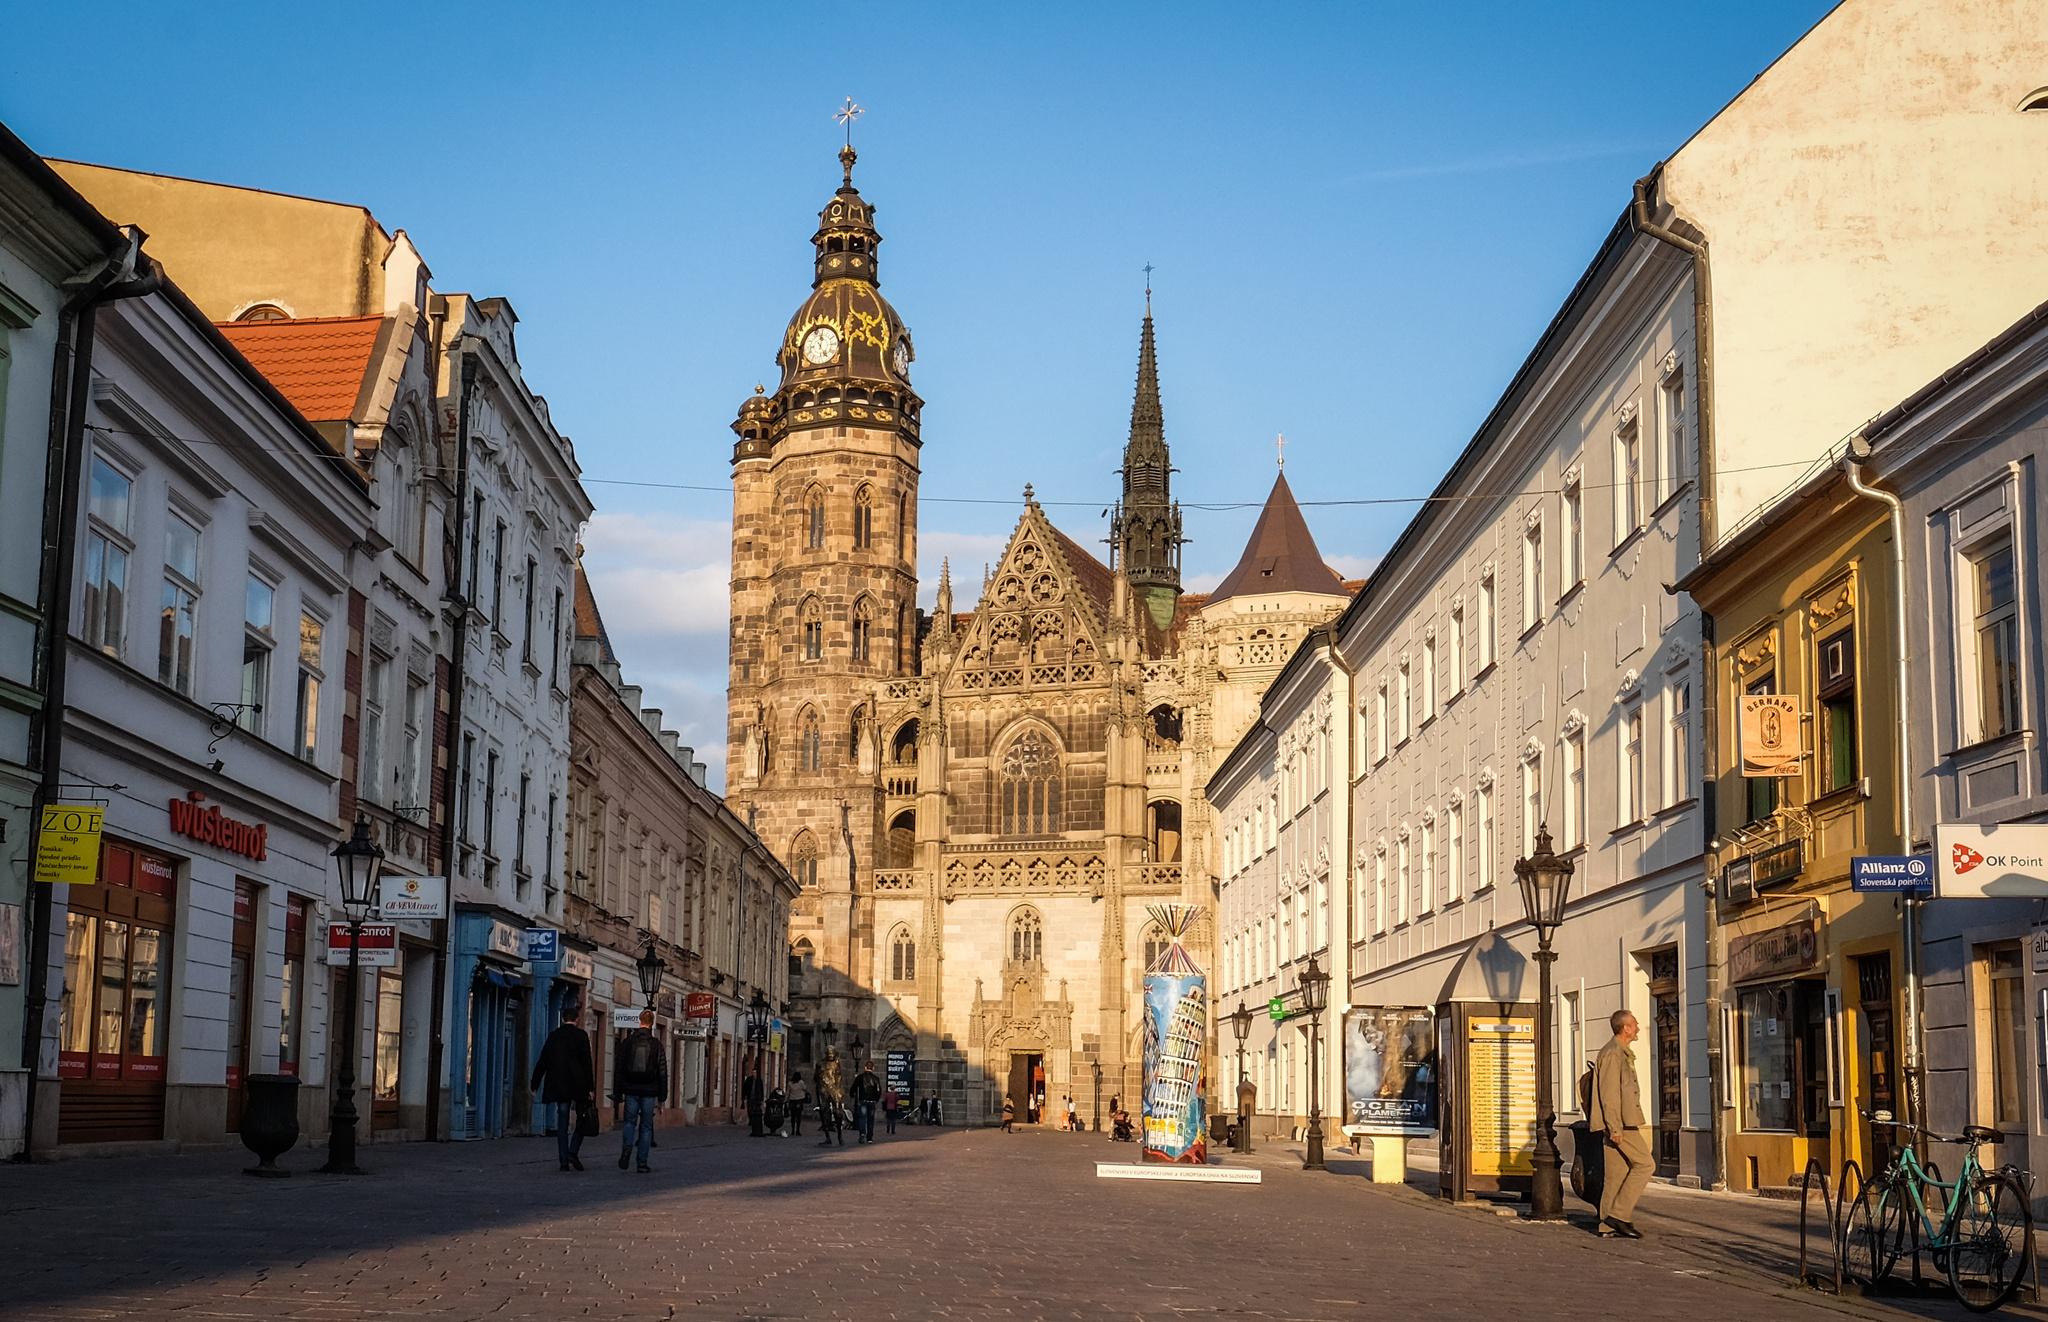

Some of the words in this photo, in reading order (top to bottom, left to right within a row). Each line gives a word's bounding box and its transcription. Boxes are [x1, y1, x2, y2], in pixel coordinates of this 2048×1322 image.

[1746, 697, 1794, 713] BERNARD
[42, 812, 102, 832] ZOE
[169, 790, 268, 861] wüstenrot
[61, 835, 78, 844] shop
[1986, 855, 2007, 867] OK
[2010, 855, 2043, 867] Point
[1860, 862, 1906, 874] Allianz
[1859, 877, 1897, 887] Slovenská
[528, 932, 552, 945] BC
